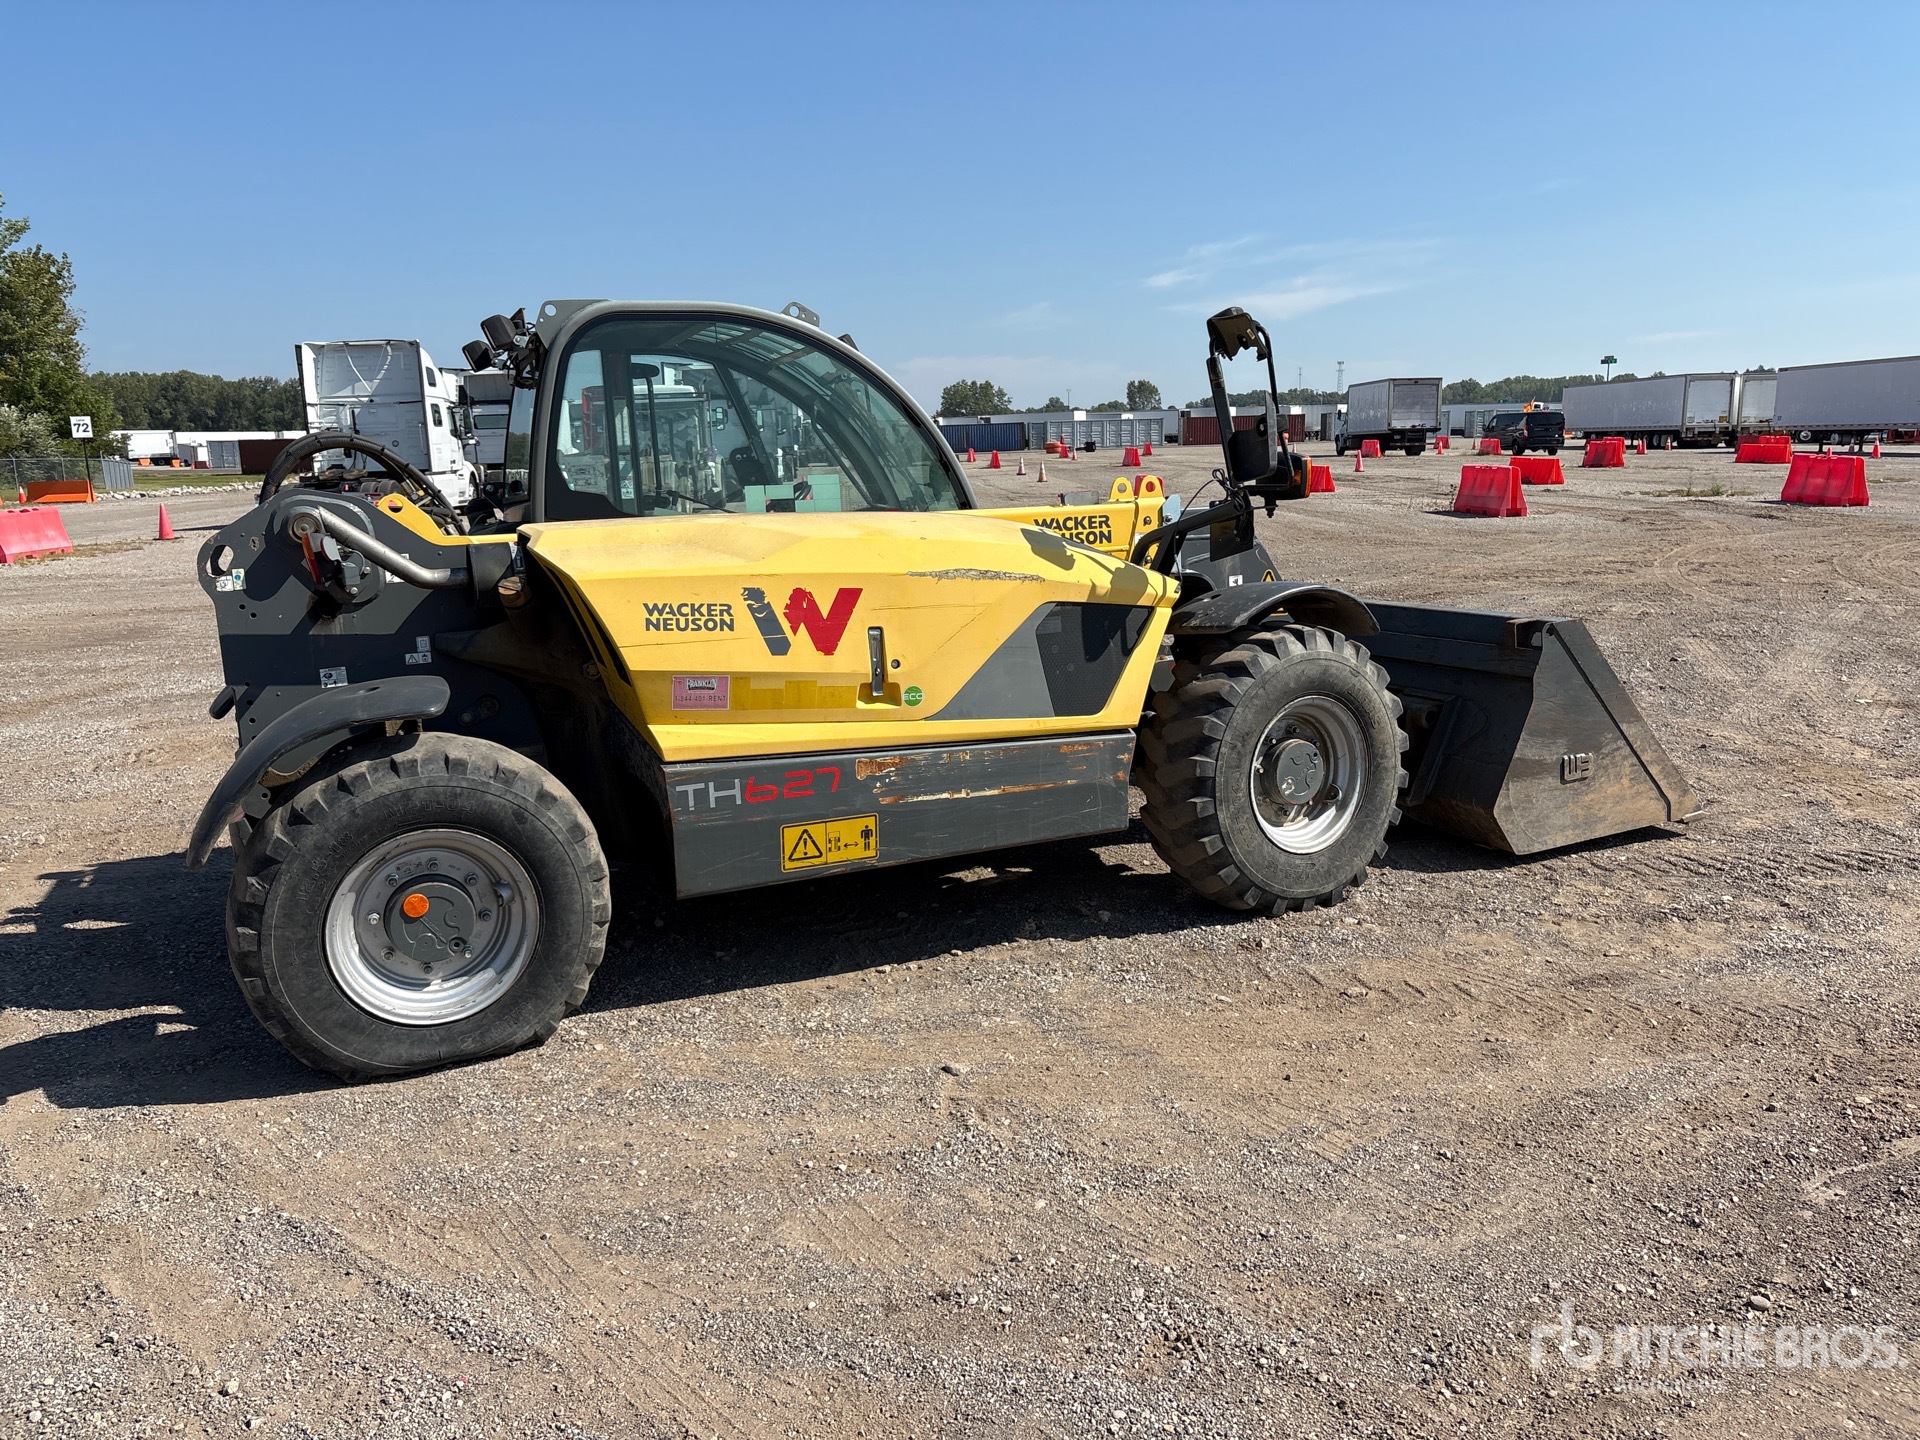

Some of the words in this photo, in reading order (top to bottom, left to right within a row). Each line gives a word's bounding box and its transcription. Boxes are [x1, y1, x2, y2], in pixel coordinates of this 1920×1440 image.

[73, 423, 90, 433] 72
[1033, 515, 1112, 532] WACKER
[1060, 530, 1113, 545] USON
[643, 603, 733, 617] WACKER
[645, 618, 734, 632] NEUSON
[676, 767, 841, 811] TH627
